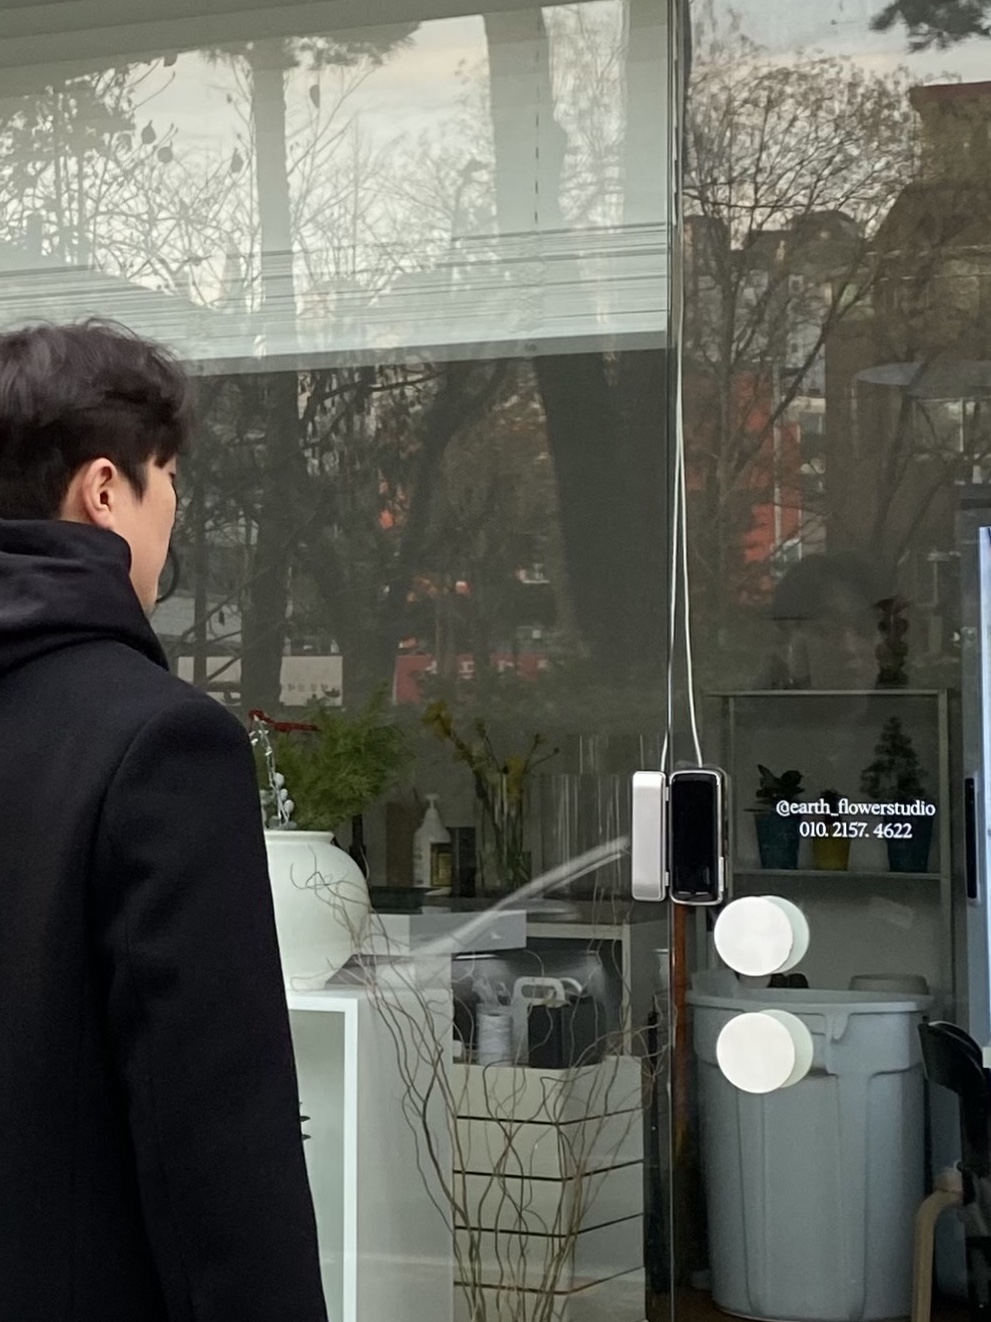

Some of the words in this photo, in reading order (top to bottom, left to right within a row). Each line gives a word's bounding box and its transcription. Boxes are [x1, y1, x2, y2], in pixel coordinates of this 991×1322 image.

[776, 798, 936, 817] @earth_flowerstudio
[799, 821, 829, 838] 010.
[832, 822, 869, 838] 2157.
[873, 822, 913, 839] 4622
